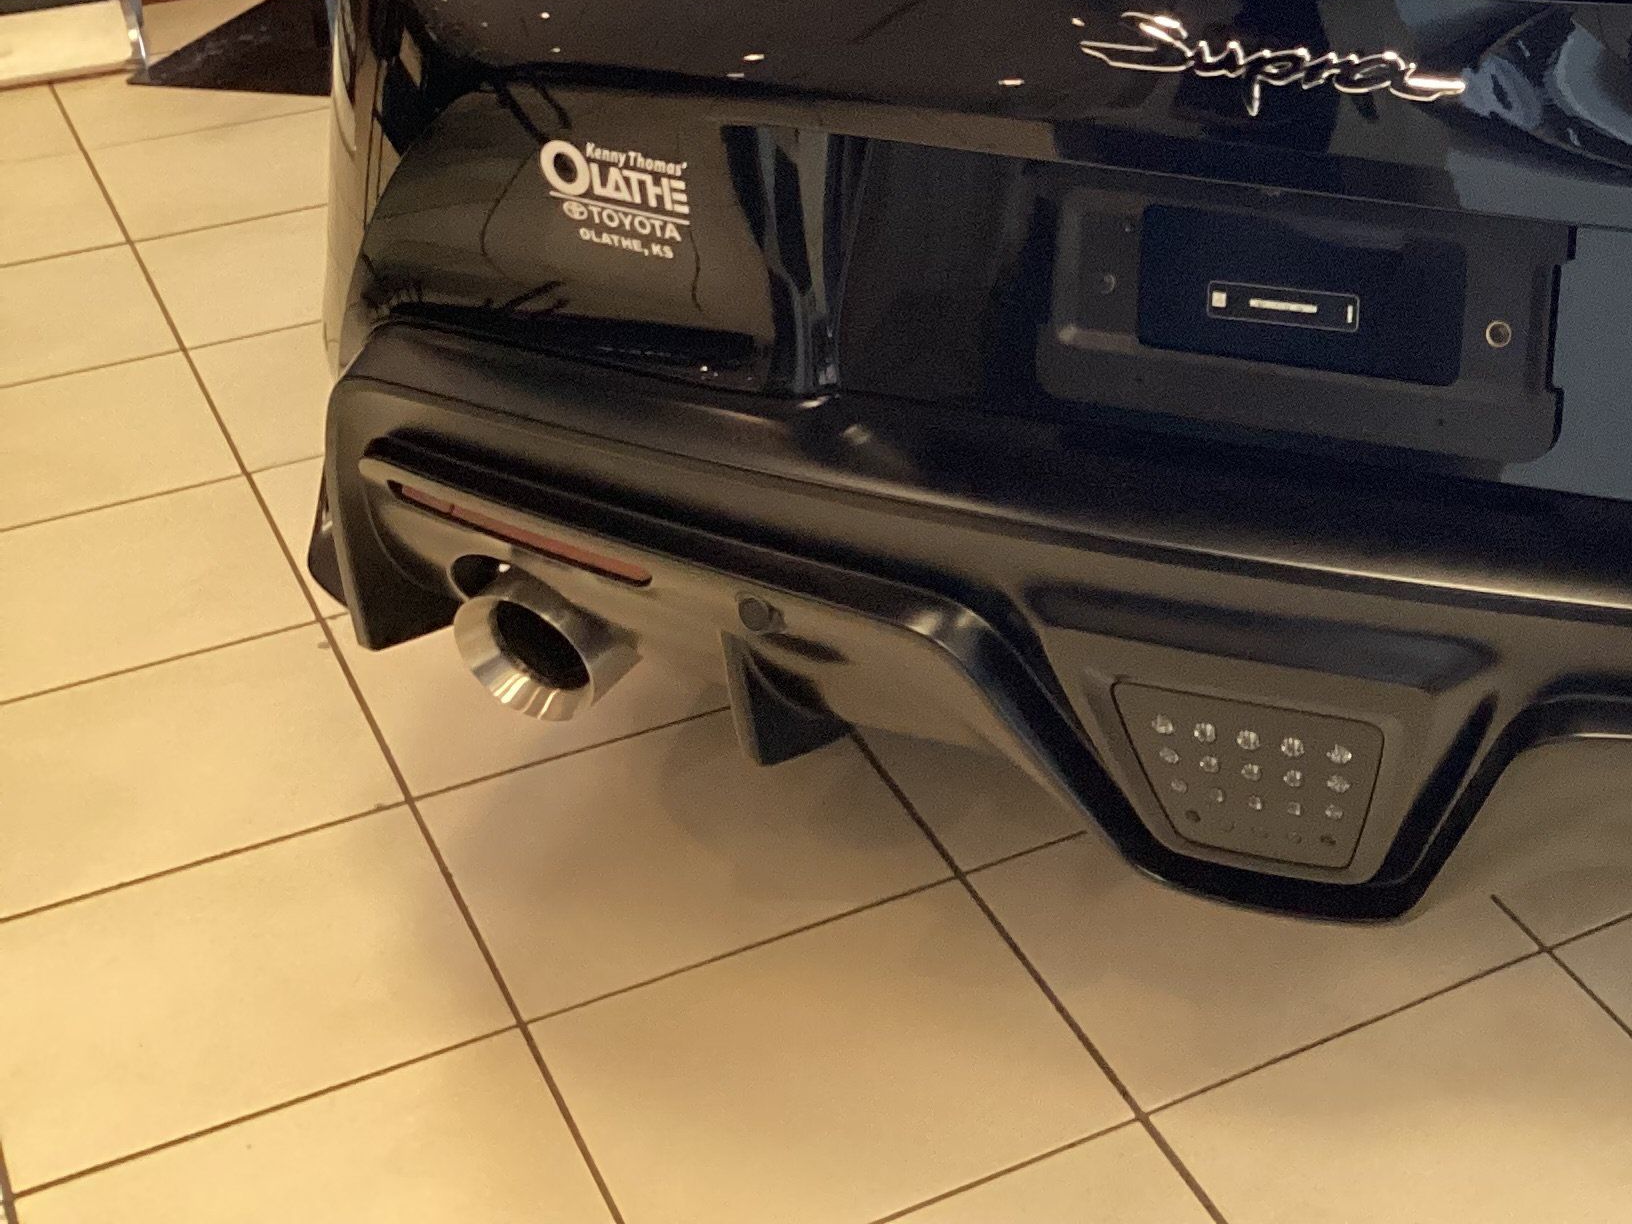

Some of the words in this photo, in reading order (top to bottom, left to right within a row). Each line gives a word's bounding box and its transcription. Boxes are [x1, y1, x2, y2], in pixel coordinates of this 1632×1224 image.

[1080, 11, 1467, 116] Supra
[586, 142, 626, 167] Kenny
[540, 139, 690, 215] OLATHE
[588, 206, 682, 242] TOYOTA
[579, 228, 649, 256] OLATHE,
[652, 243, 673, 259] KS
